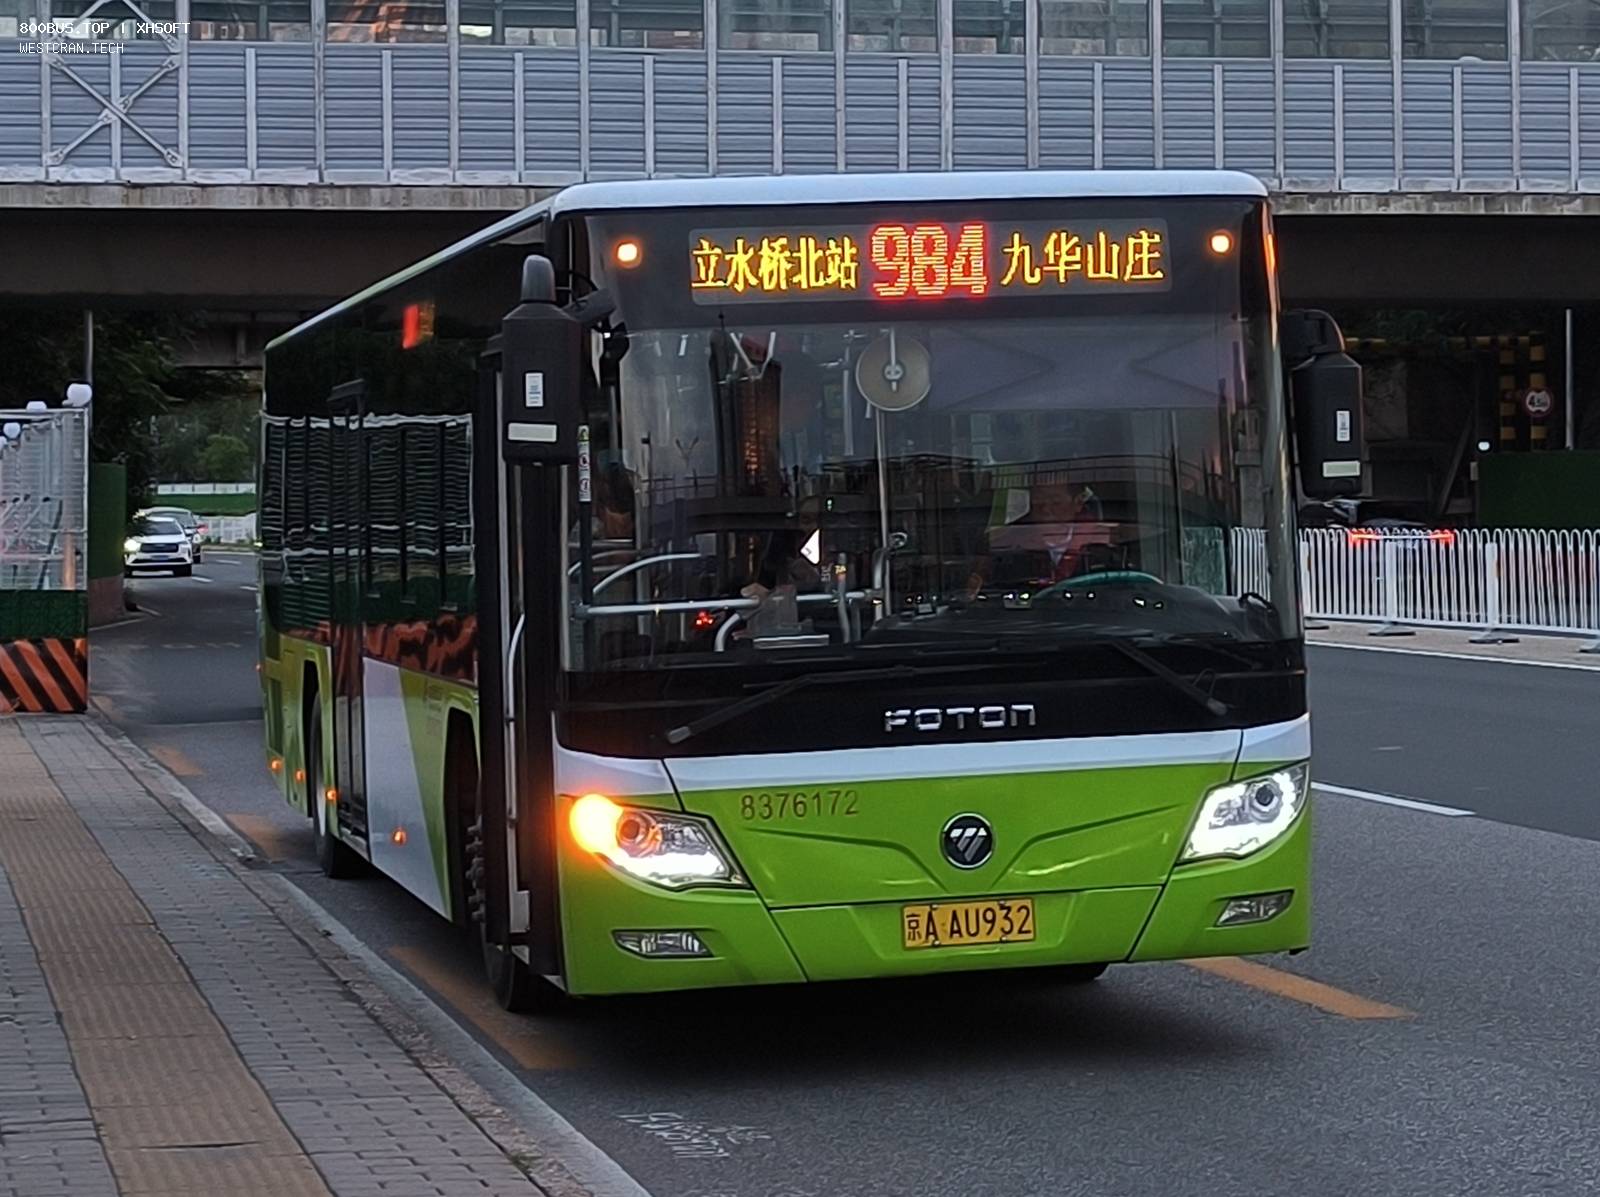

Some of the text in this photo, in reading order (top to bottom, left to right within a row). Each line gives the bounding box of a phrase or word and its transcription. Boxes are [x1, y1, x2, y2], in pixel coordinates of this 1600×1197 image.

[691, 223, 1165, 298] 立水桥北站 984 九华山庄
[884, 704, 1036, 732] FOTON
[741, 790, 860, 820] 8376172
